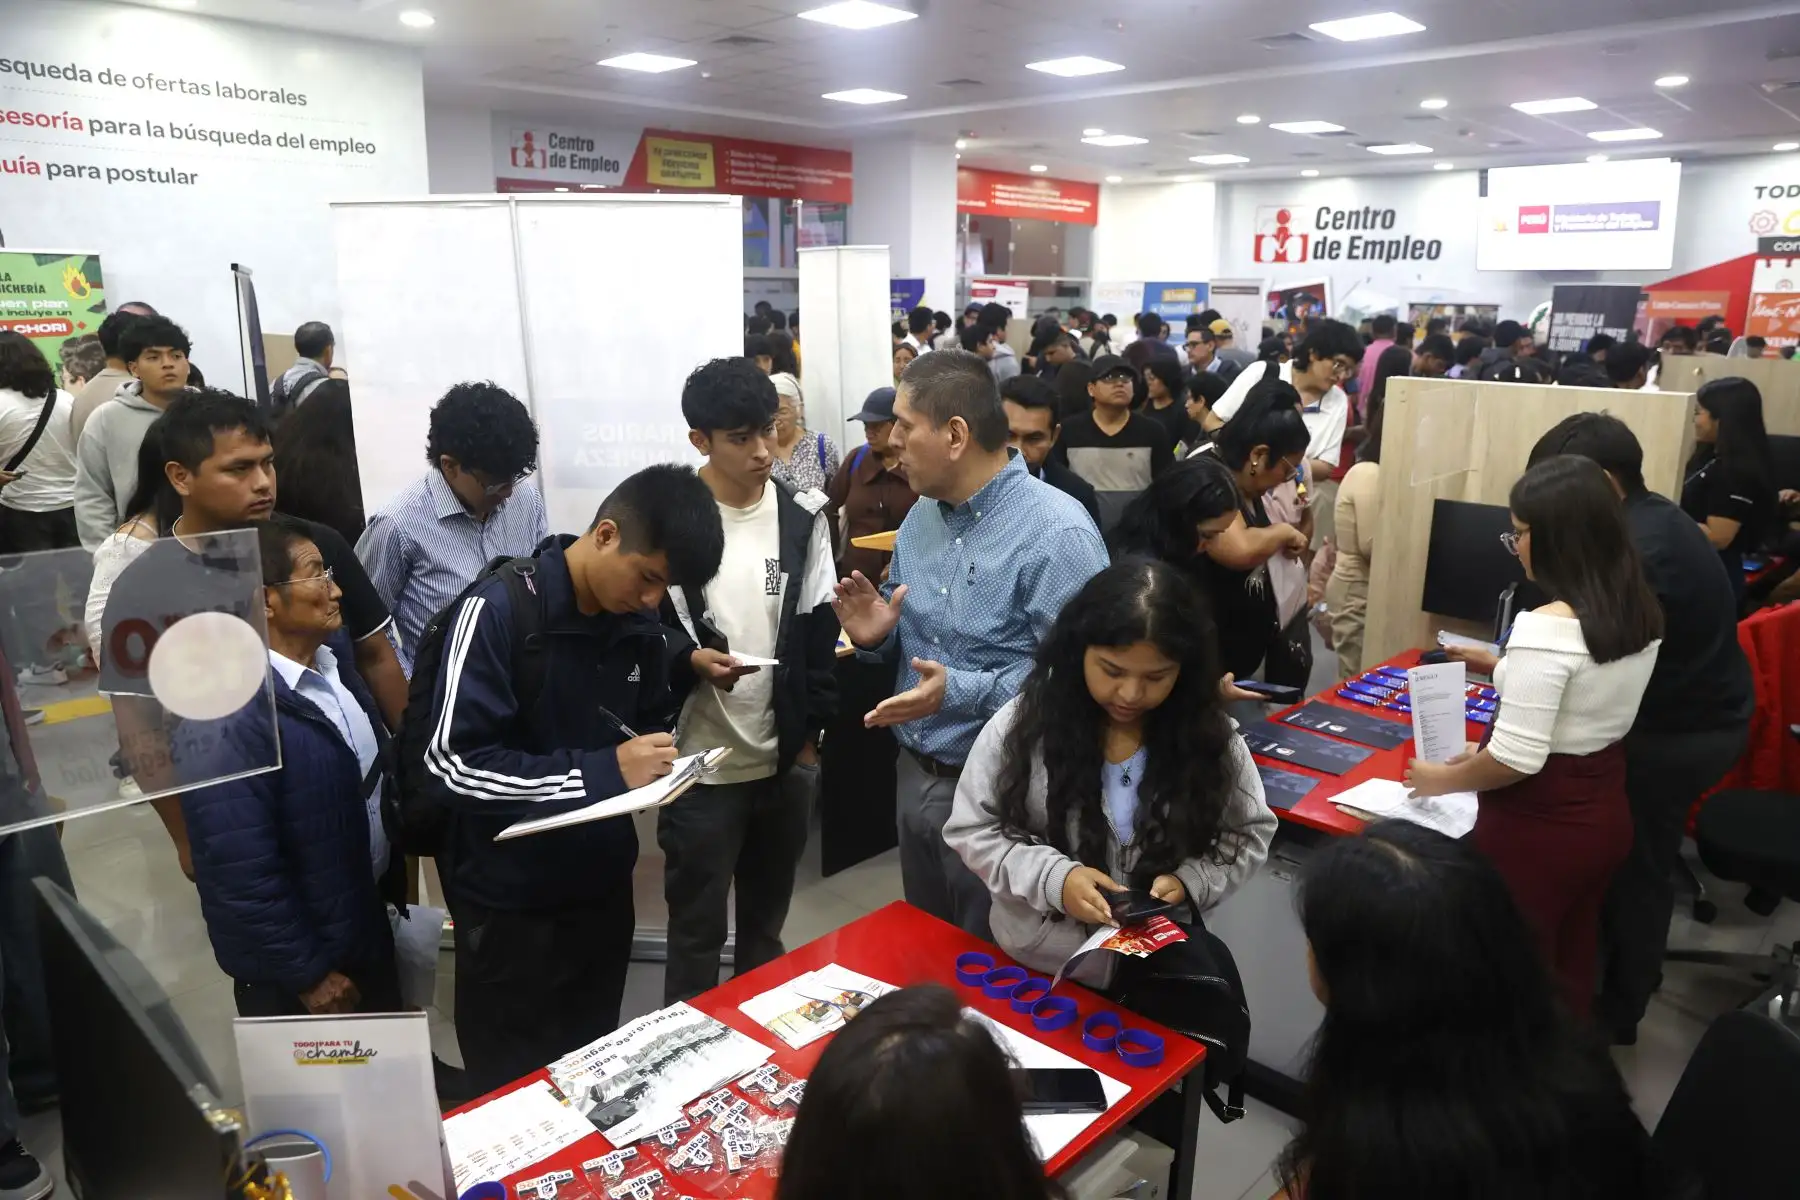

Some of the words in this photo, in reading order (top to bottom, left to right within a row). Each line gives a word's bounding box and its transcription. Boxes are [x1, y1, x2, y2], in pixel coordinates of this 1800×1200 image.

[98, 70, 126, 87] de
[132, 72, 211, 97] ofertas
[216, 80, 307, 106] laborales
[89, 117, 141, 137] para
[147, 119, 165, 139] la
[170, 122, 272, 147] búsqueda
[276, 129, 305, 149] del
[309, 136, 376, 156] empleo
[549, 132, 594, 152] Centro
[0, 156, 41, 176] uía
[46, 160, 101, 180] para
[106, 166, 199, 186] postular
[549, 152, 567, 168] de
[570, 153, 619, 174] Empleo
[1754, 185, 1800, 200] TOD
[1315, 206, 1396, 231] Centro
[1312, 236, 1341, 260] de
[1347, 234, 1442, 264] Empleo
[8, 309, 53, 317] incluye
[13, 323, 68, 334] CHORI
[306, 1040, 378, 1059] chamba
